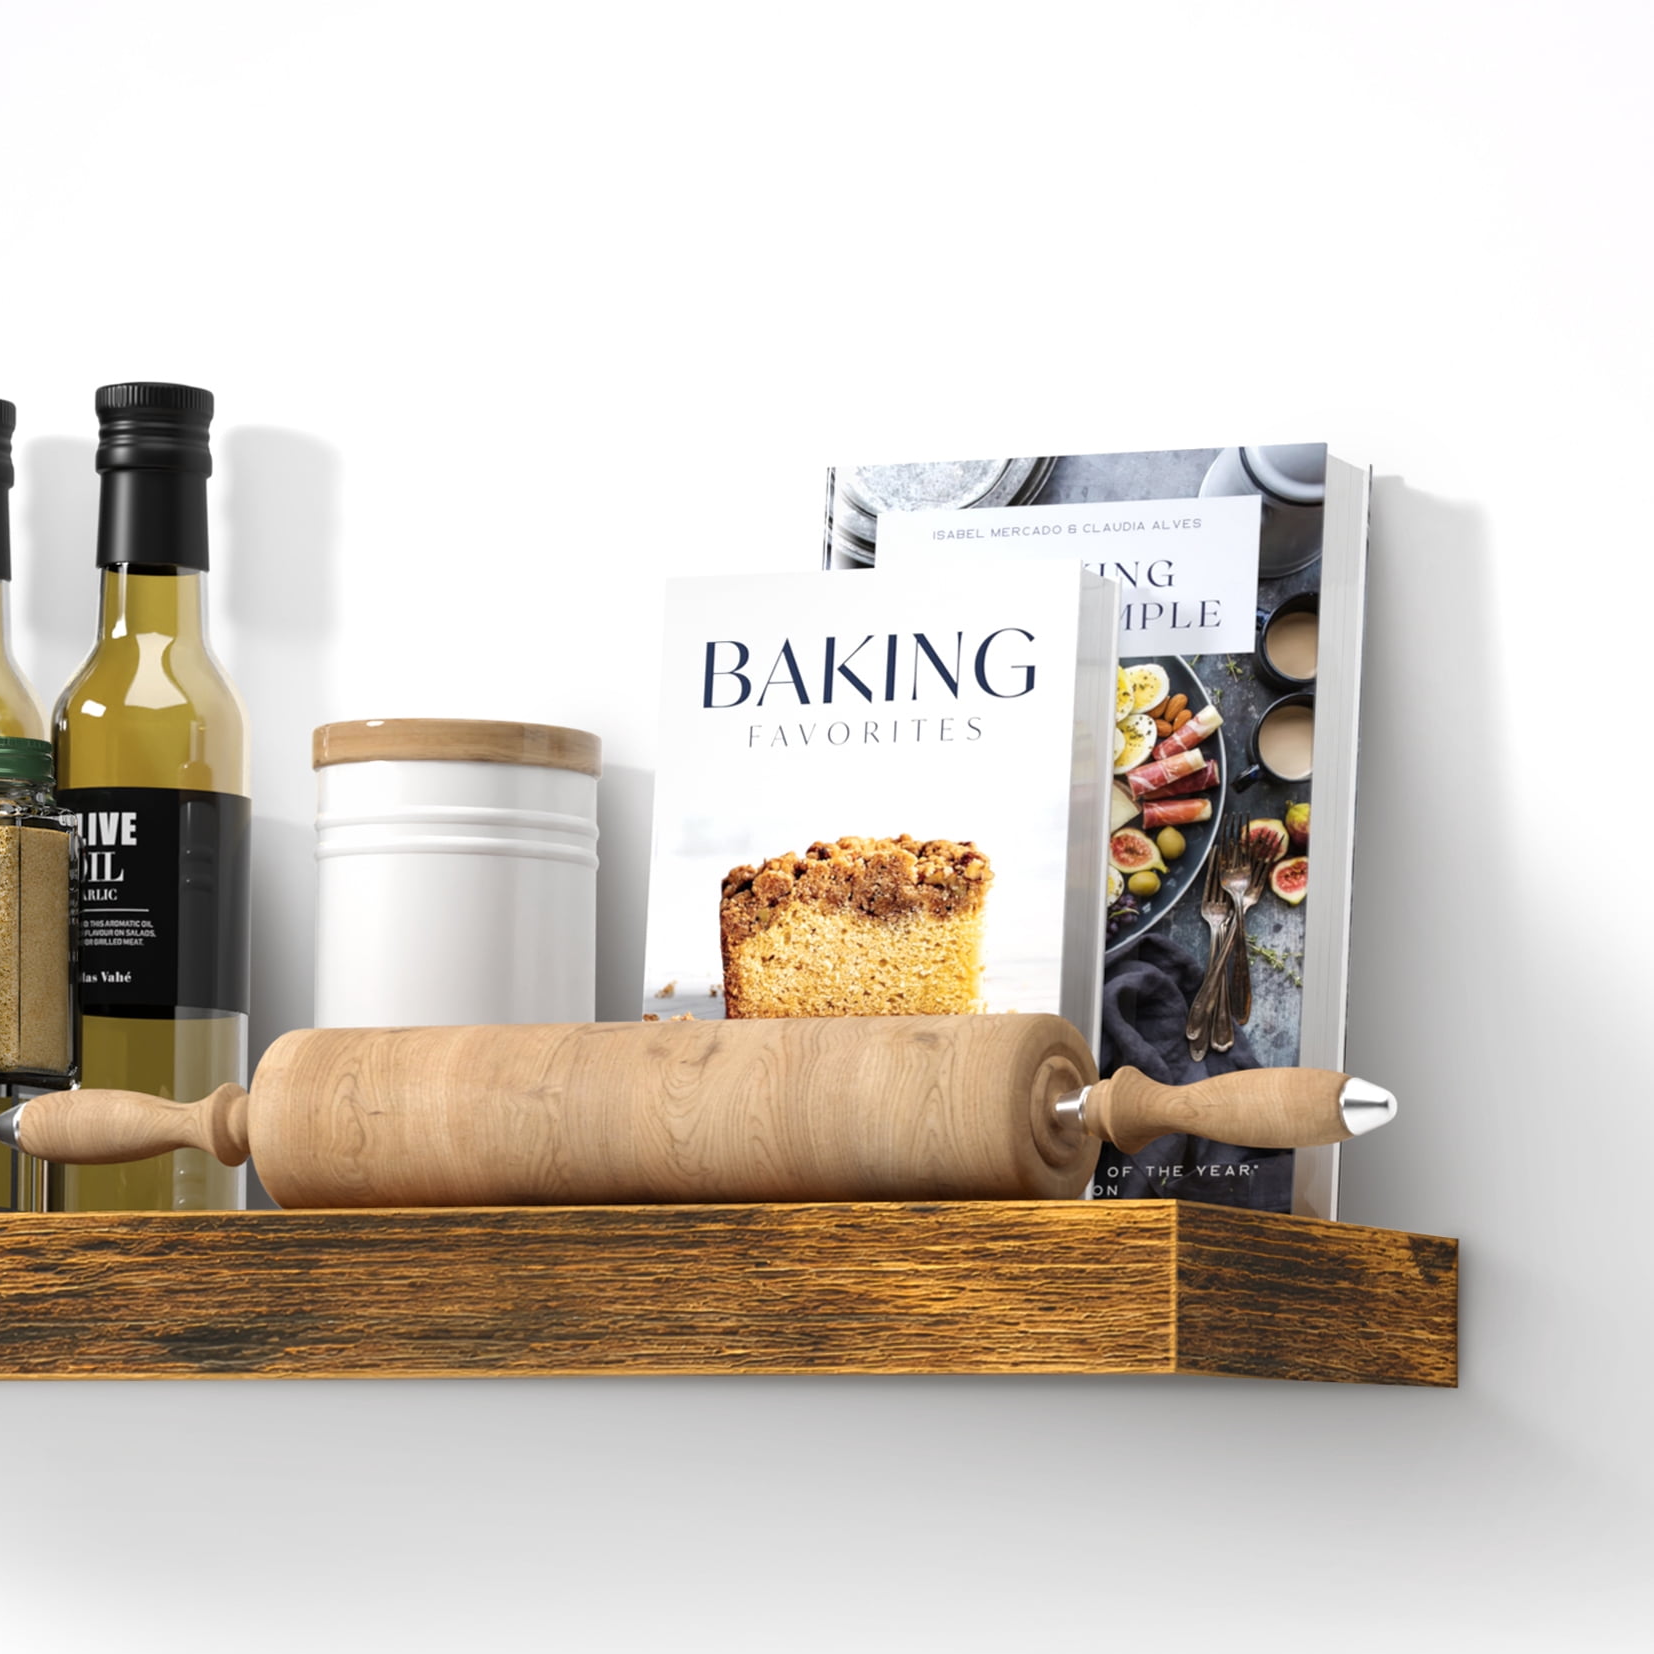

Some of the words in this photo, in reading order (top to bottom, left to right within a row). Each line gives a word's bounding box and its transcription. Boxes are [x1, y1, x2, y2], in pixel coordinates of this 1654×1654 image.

[932, 528, 985, 541] ISABEL
[990, 524, 1063, 538] MERCADO
[1067, 523, 1078, 535] &
[1082, 520, 1146, 534] CLAUDIA
[1151, 518, 1202, 531] ALVES
[1084, 559, 1176, 588] ING
[703, 627, 1036, 708] BAKING
[748, 716, 983, 748] FAVORITES
[83, 851, 125, 882] IL
[83, 888, 118, 901] RLIC
[105, 920, 140, 928] AROMATIC
[101, 970, 132, 983] Vahé
[1107, 1166, 1134, 1178] OF
[1145, 1165, 1184, 1177] THE
